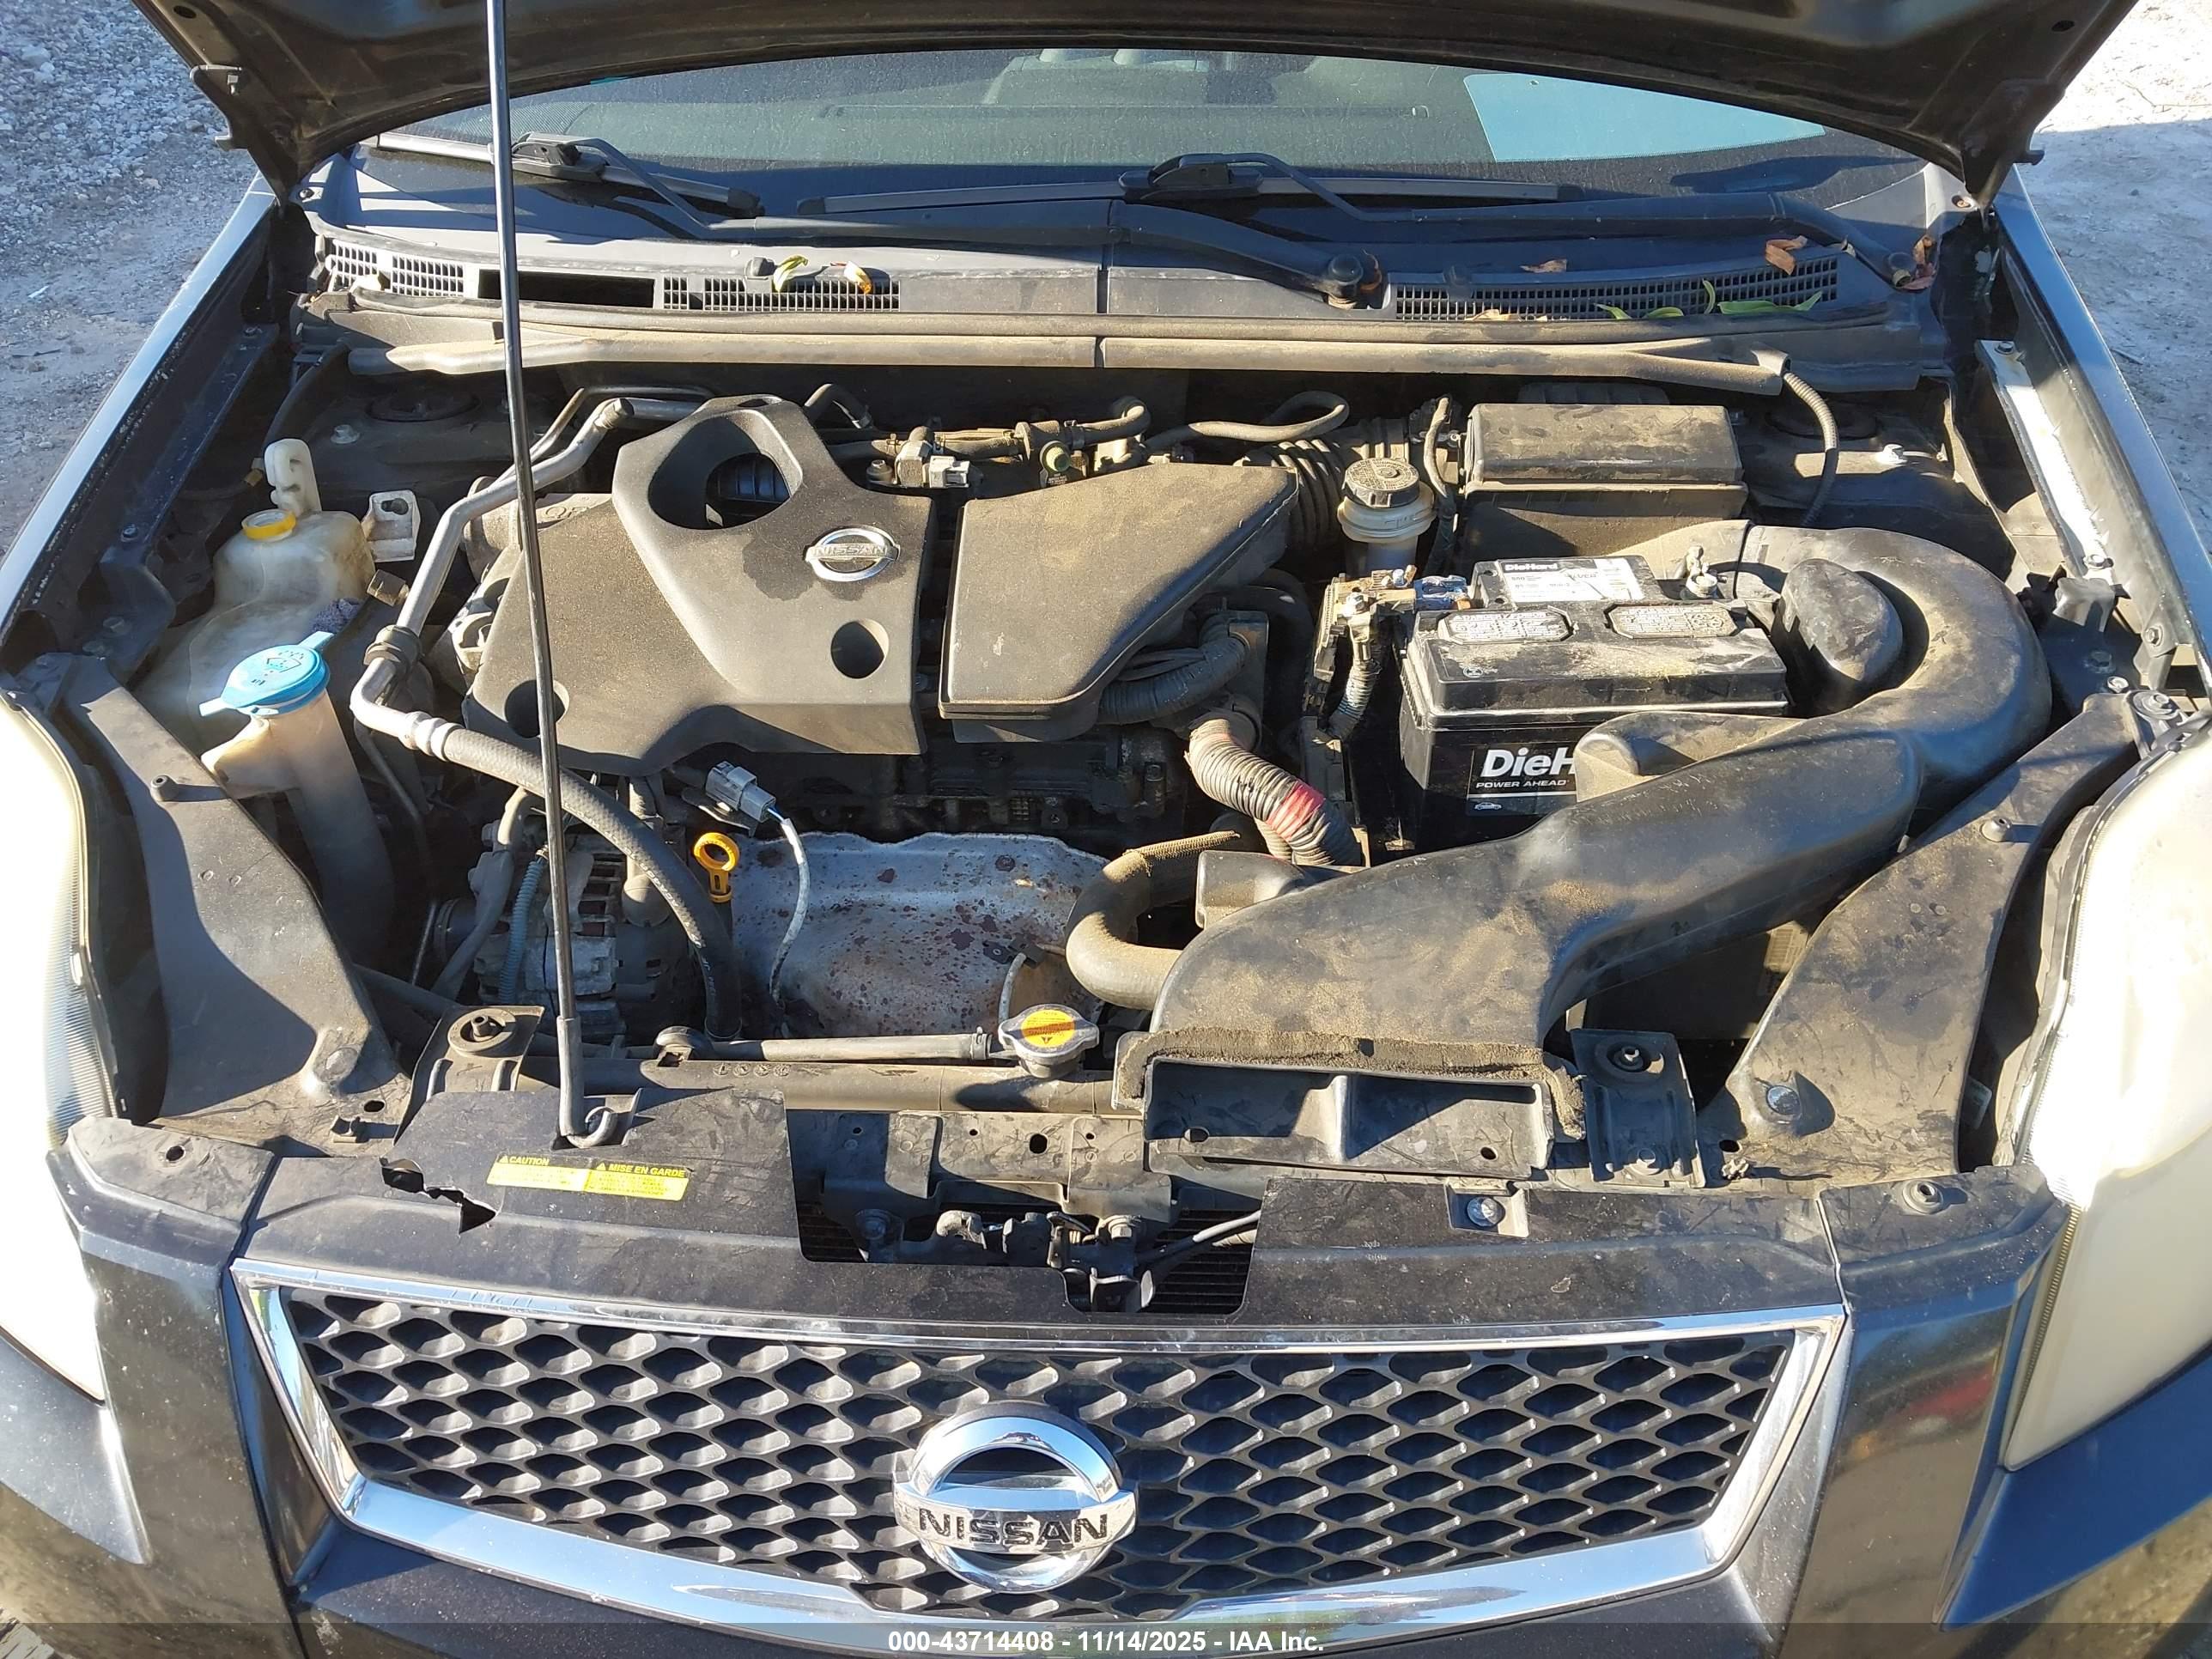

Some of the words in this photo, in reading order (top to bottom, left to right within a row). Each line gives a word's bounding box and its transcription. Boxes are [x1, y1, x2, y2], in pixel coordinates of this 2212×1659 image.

[814, 544, 888, 556] NISSAN
[509, 1156, 550, 1165] CAUTION
[608, 1164, 634, 1173] MISE
[635, 1165, 649, 1175] EN
[650, 1167, 686, 1178] GARDE
[918, 1507, 1109, 1547] NISSAN
